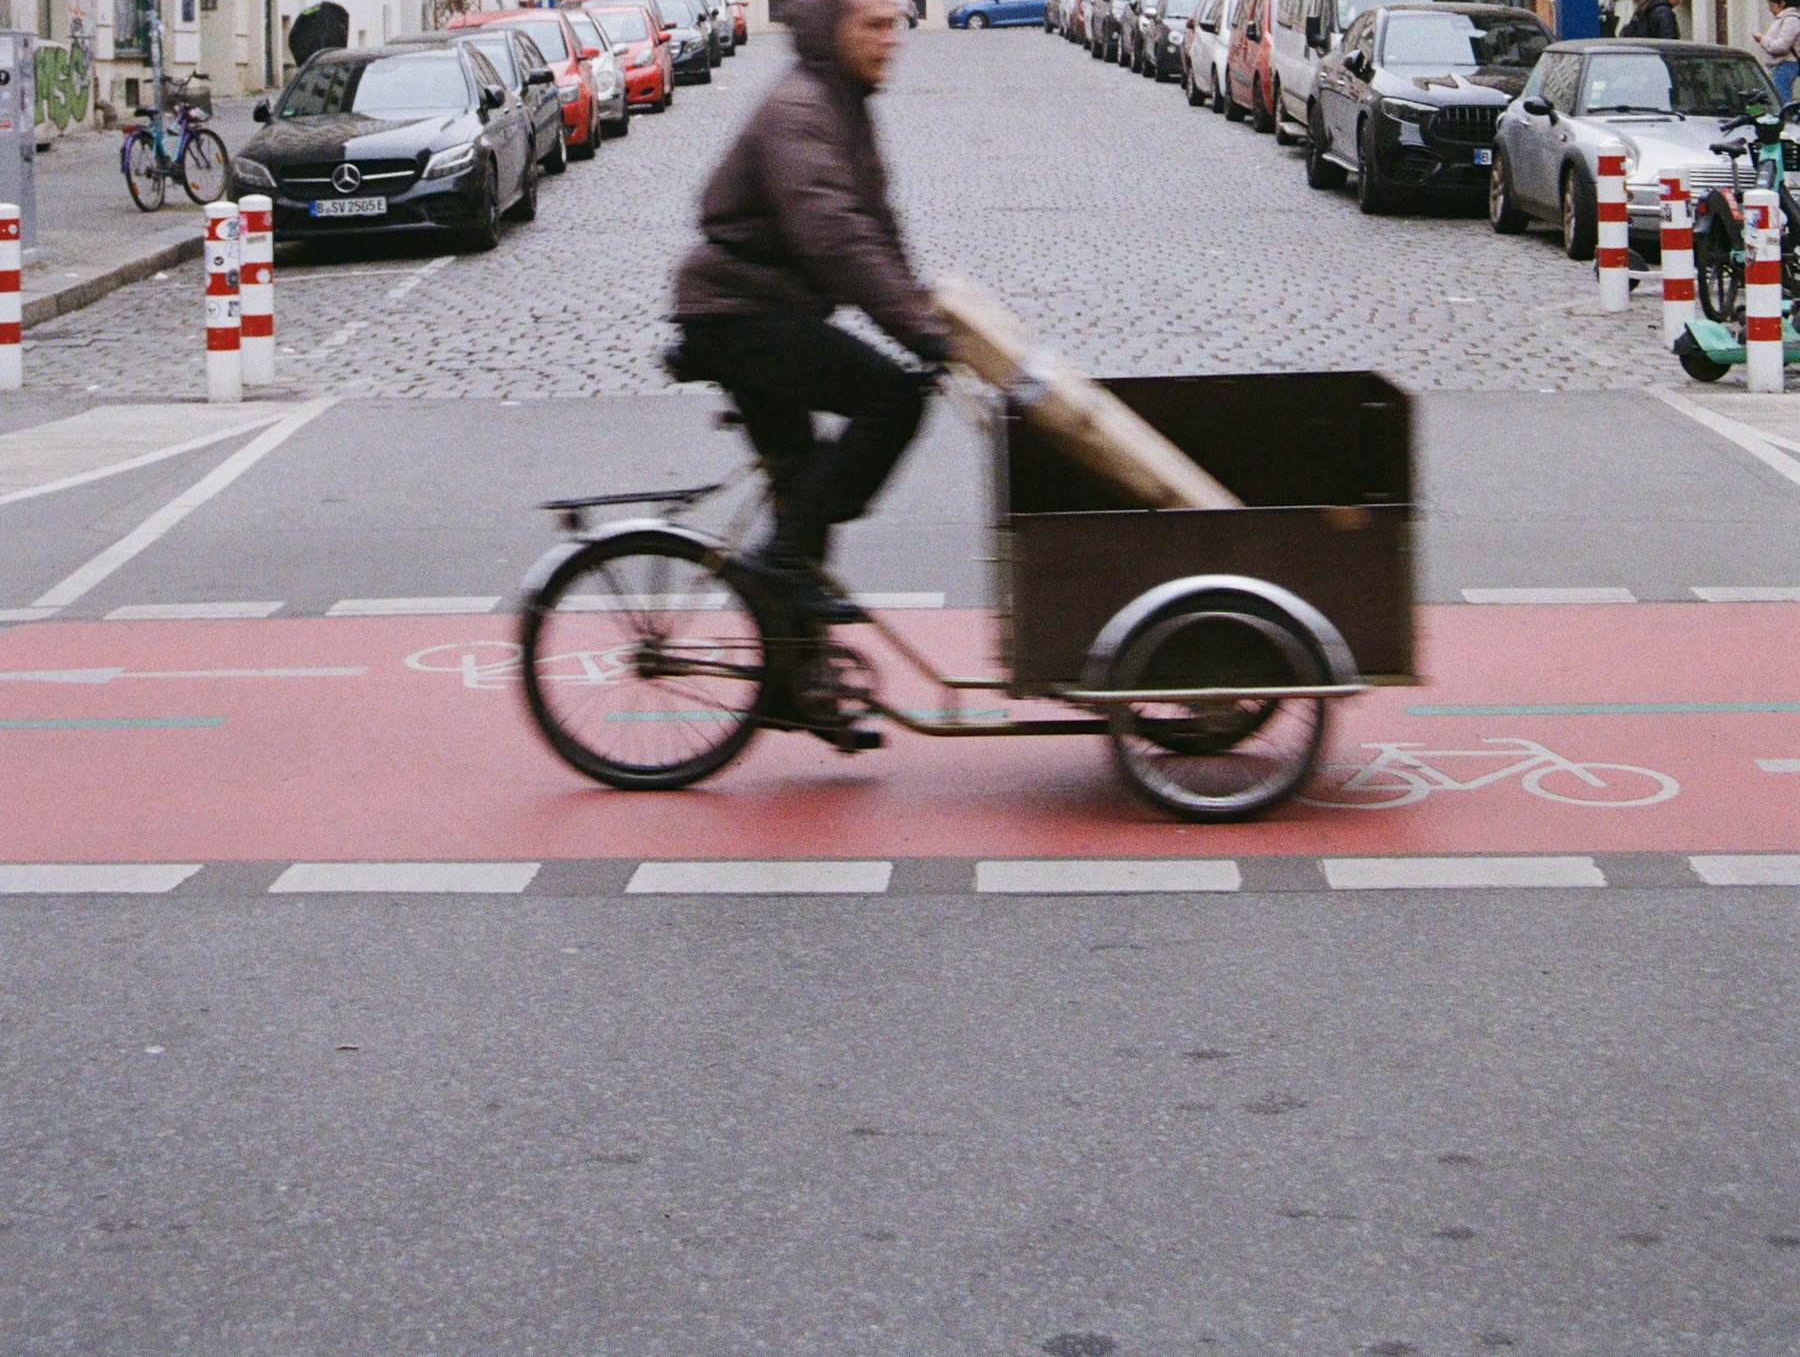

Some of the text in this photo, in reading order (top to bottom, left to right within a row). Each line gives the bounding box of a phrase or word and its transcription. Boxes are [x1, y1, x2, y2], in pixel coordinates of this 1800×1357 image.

[1481, 152, 1490, 163] B
[316, 202, 325, 214] B
[331, 201, 346, 213] SV
